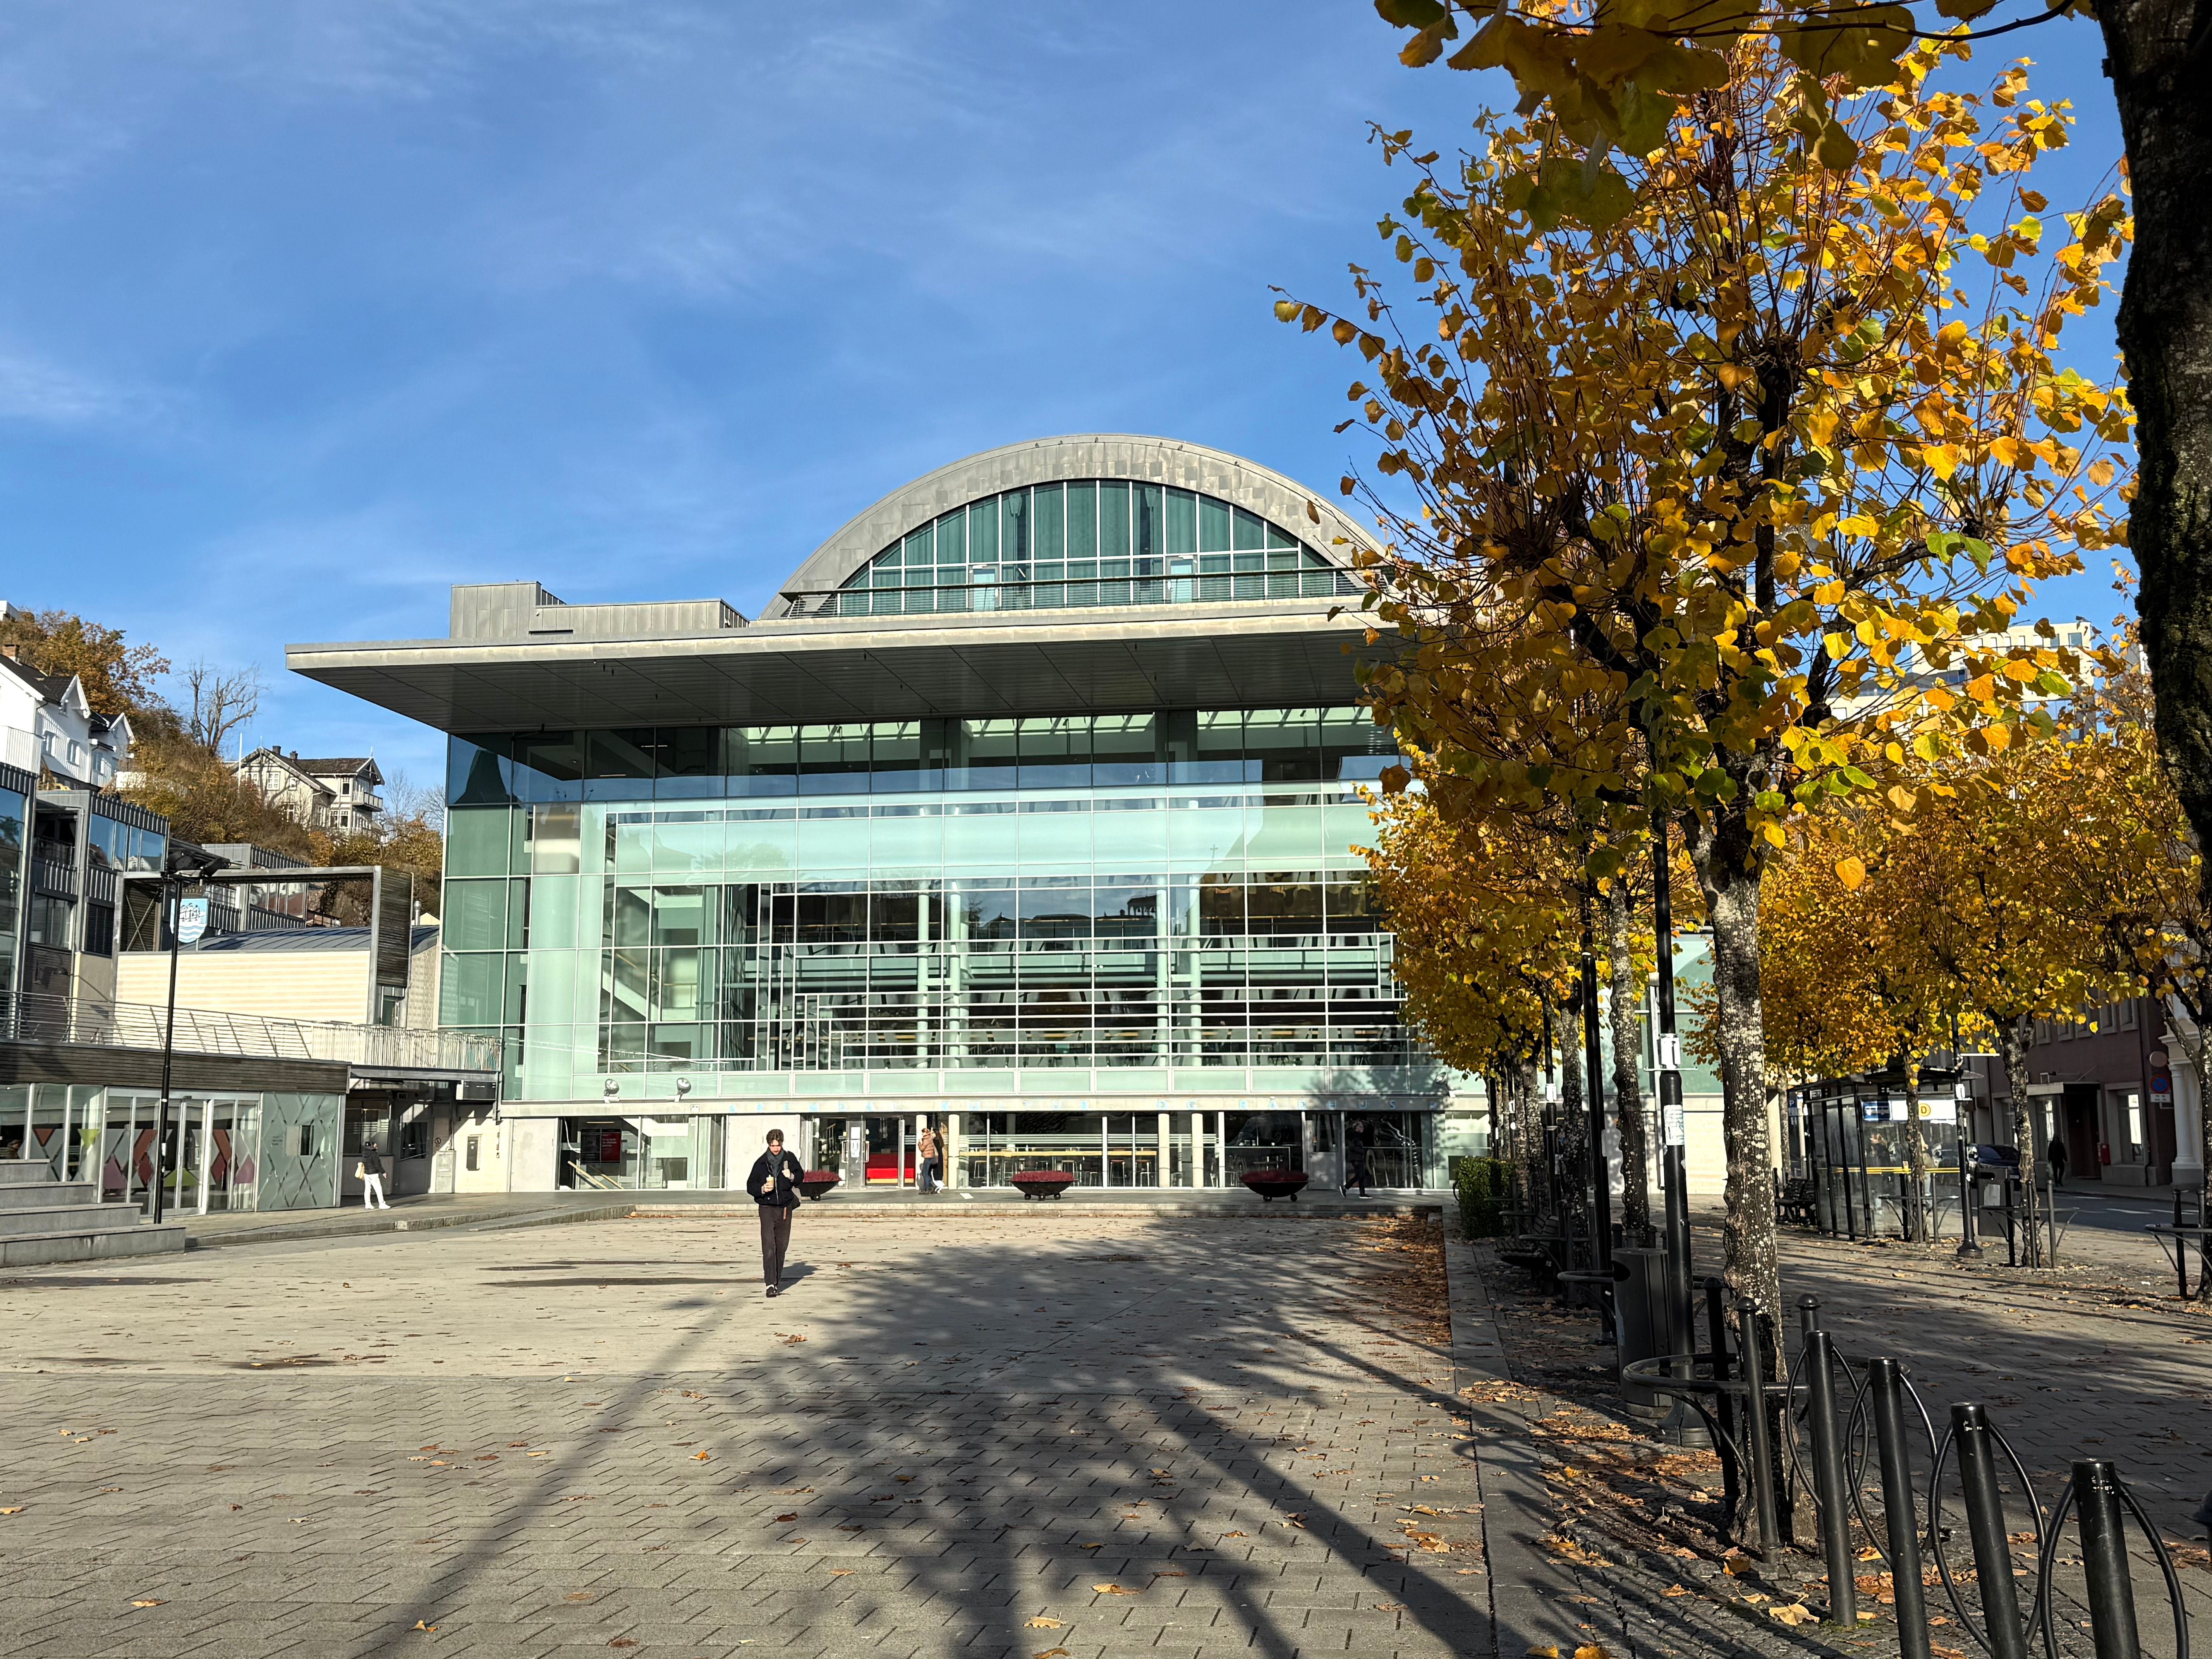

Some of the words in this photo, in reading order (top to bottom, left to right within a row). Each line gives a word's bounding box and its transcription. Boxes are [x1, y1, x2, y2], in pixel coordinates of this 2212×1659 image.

[729, 1102, 903, 1112] ARENDAL
[1156, 1099, 1197, 1110] OG
[1239, 1096, 1396, 1110] RÅDHUS
